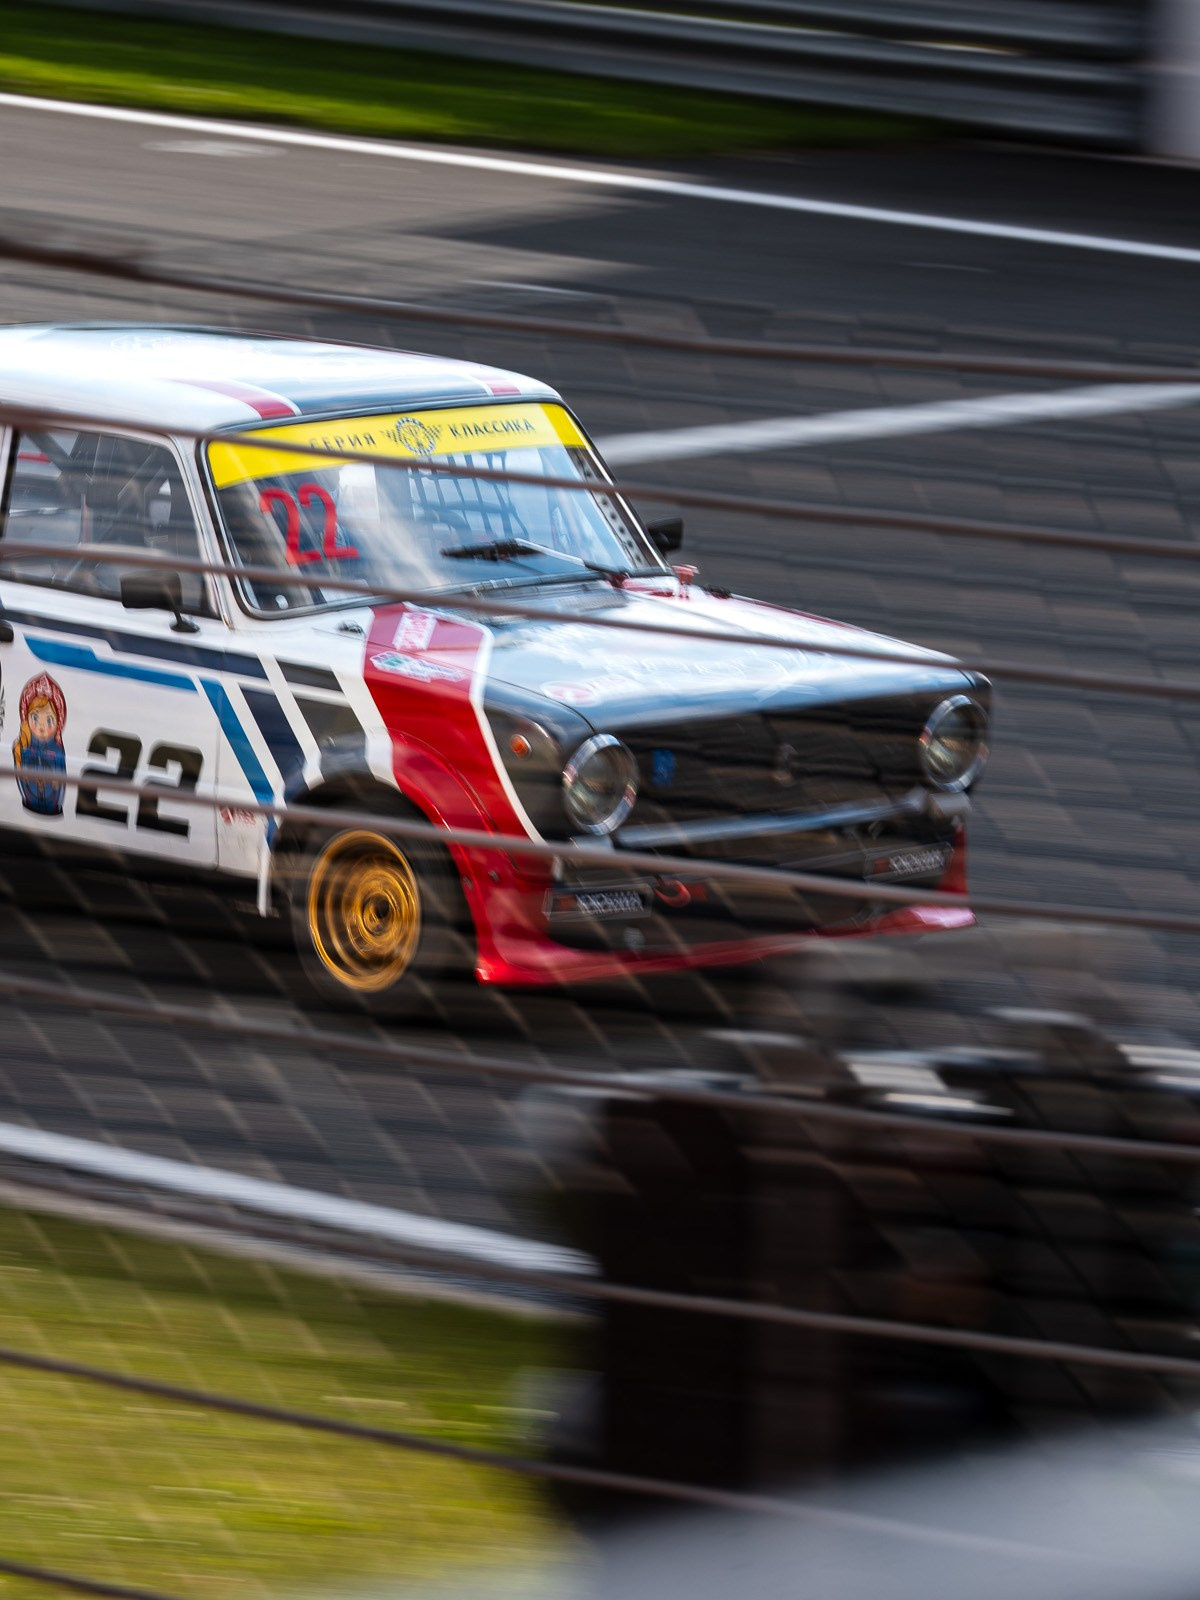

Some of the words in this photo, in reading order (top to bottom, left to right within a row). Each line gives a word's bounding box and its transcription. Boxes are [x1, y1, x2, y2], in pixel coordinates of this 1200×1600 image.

[308, 432, 376, 452] СЕРИЯ
[447, 418, 536, 438] КЛАССИКА
[259, 482, 361, 566] 22
[76, 728, 203, 838] 22
